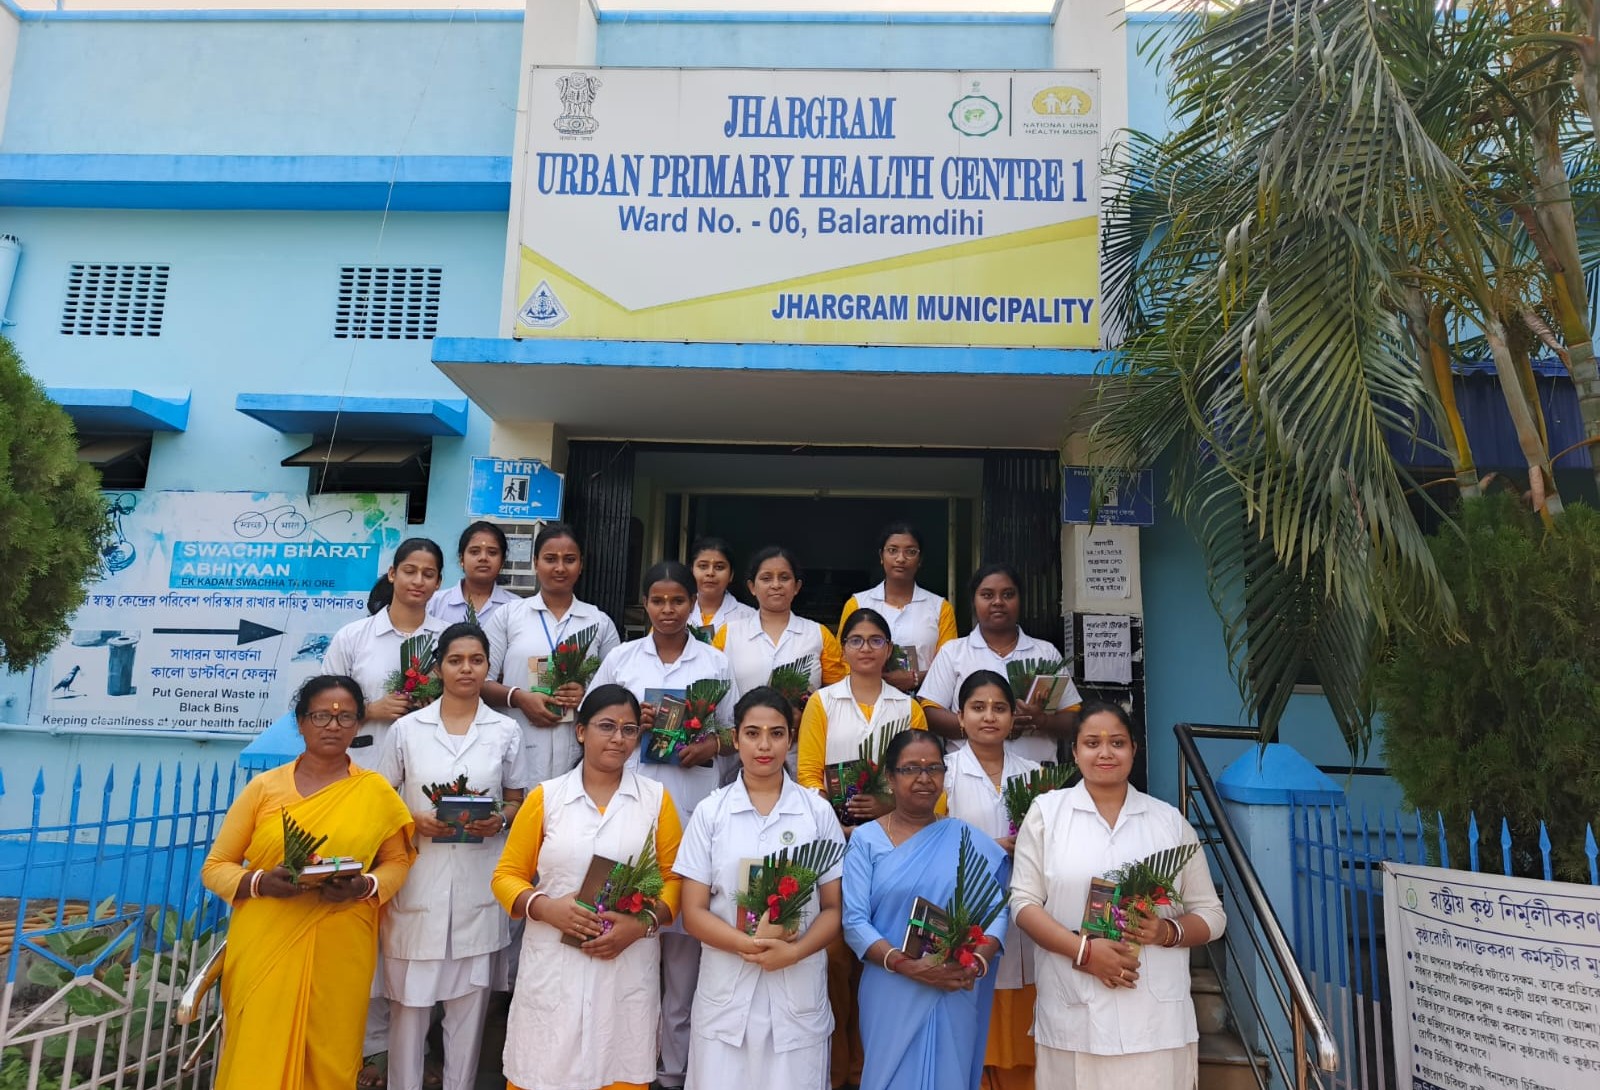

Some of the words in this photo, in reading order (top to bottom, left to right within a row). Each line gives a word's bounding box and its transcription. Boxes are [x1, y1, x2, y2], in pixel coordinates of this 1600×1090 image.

[724, 95, 896, 140] JHARGRAM
[537, 152, 642, 197] URBAN
[648, 154, 794, 199] PRIMARY
[800, 155, 934, 200] HEALTH
[941, 156, 1065, 202] CENTRE
[1071, 159, 1088, 203] 1
[619, 205, 688, 234] Ward
[699, 207, 742, 234] No.
[769, 207, 808, 239] 06,
[818, 208, 984, 236] Balaramdihi
[772, 293, 909, 322] JHARGRAM
[917, 295, 1094, 325] MUNICIPALITY
[494, 461, 541, 475] ENTRY
[498, 504, 530, 515] প্রবেশ
[281, 521, 300, 530] भारत
[183, 543, 277, 559] SWACHH
[283, 545, 371, 559] BHARAT
[180, 562, 290, 577] ABHIYAAN
[181, 577, 194, 586] EK
[197, 578, 233, 587] KADAM
[235, 578, 285, 588] SWACHHA
[314, 579, 336, 588] ORE
[92, 594, 116, 608] স্বাস্থ্য
[119, 595, 156, 608] কেন্দ্রের
[159, 591, 200, 608] পরিবেশ
[246, 596, 276, 609] রাখার
[278, 592, 311, 612] দায়িত্ব
[170, 648, 212, 661] সাধারন
[214, 647, 262, 662] আবর্জনা
[151, 667, 185, 679] কালো
[188, 664, 239, 680] ডাস্টবিনে
[241, 668, 278, 682] ফেলুন
[152, 687, 171, 698] Put
[174, 687, 218, 699] General
[221, 688, 256, 699] Waste
[258, 689, 269, 700] in
[179, 702, 210, 713] Black
[213, 703, 239, 713] Bins
[42, 715, 87, 727] Keeping
[90, 716, 155, 727] cleanliness
[171, 718, 197, 729] your
[200, 718, 235, 729] health
[1429, 886, 1465, 916] রাষ্ট্রীয়
[1469, 891, 1495, 923] কুষ্ঠ
[1519, 946, 1581, 973] কর্মসূচীর
